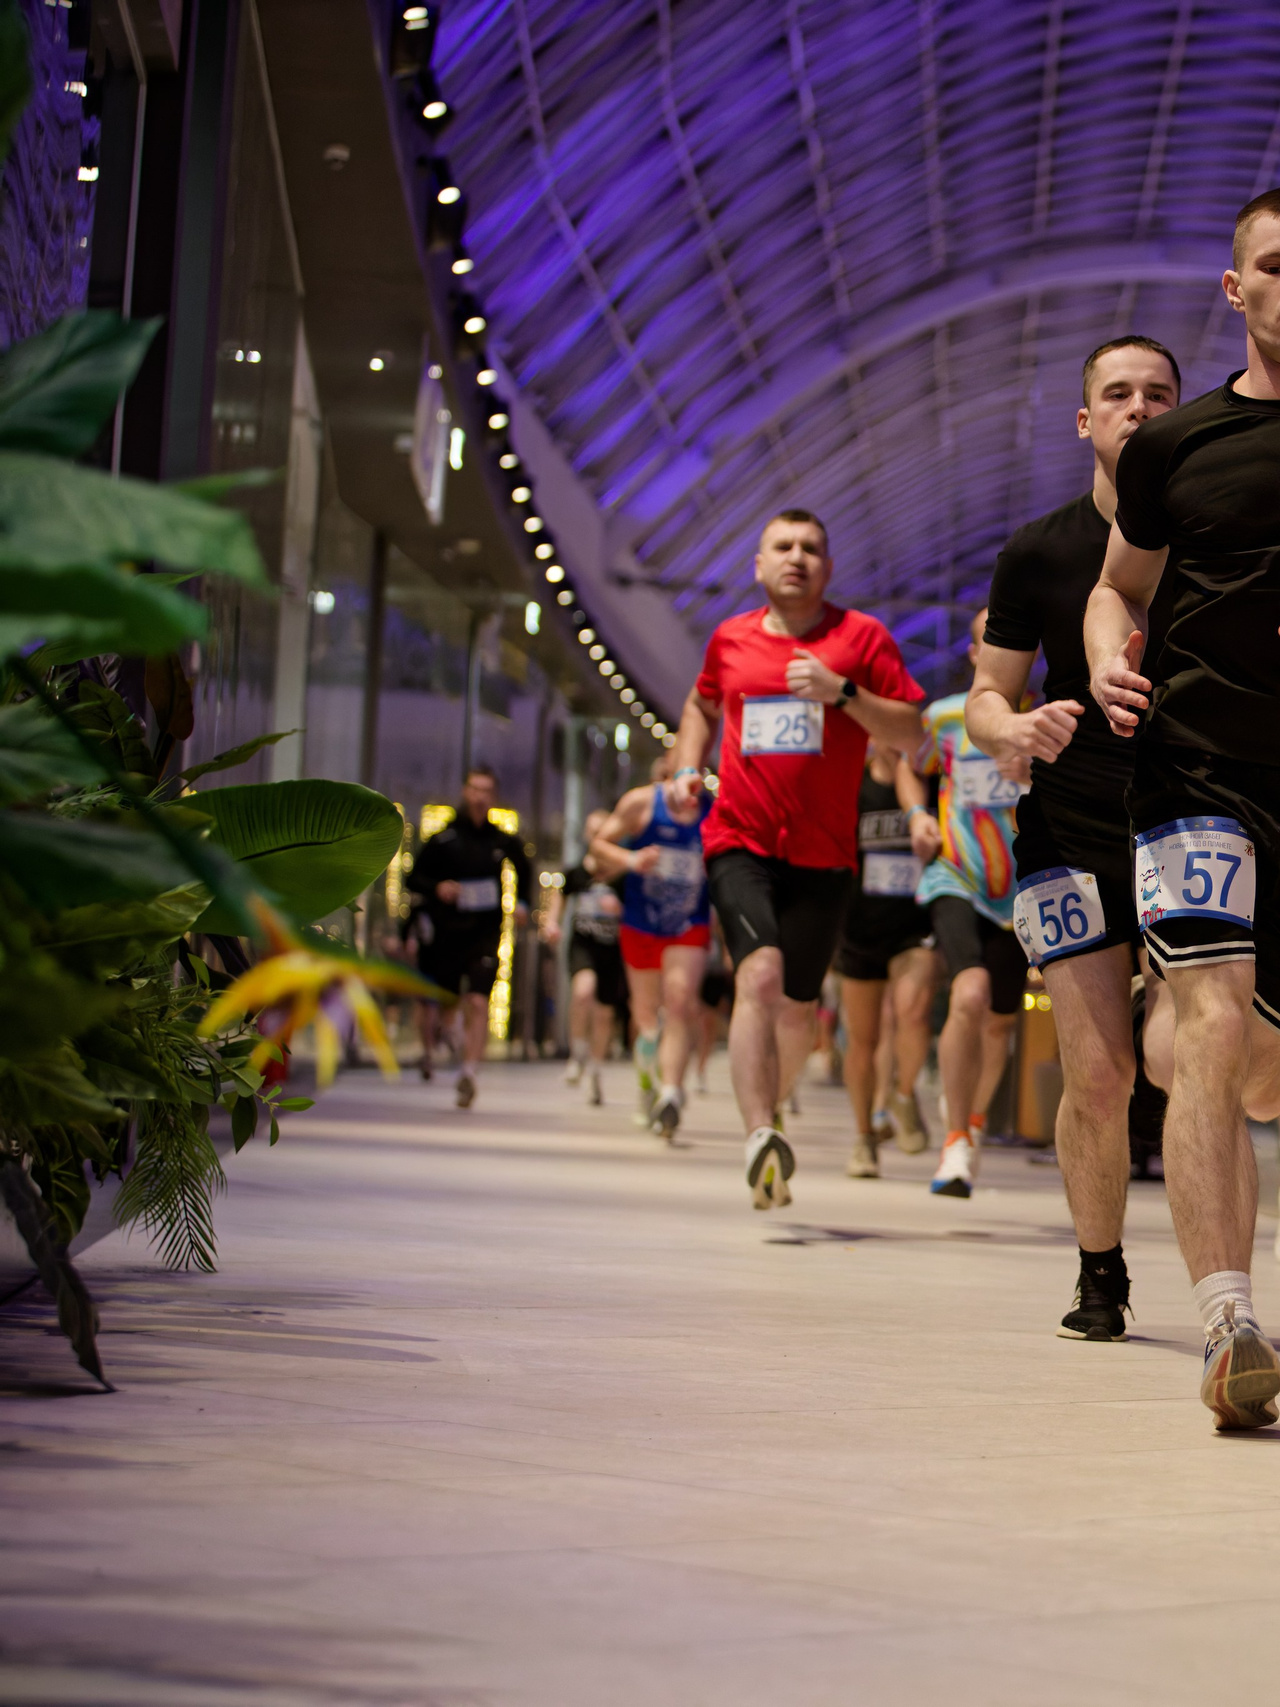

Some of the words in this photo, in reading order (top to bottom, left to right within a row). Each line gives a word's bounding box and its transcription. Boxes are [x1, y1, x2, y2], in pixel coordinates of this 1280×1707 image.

[773, 713, 809, 746] 25
[1204, 832, 1222, 840] ЗАБЕГ
[1182, 850, 1242, 909] 57
[1038, 891, 1089, 947] 56
